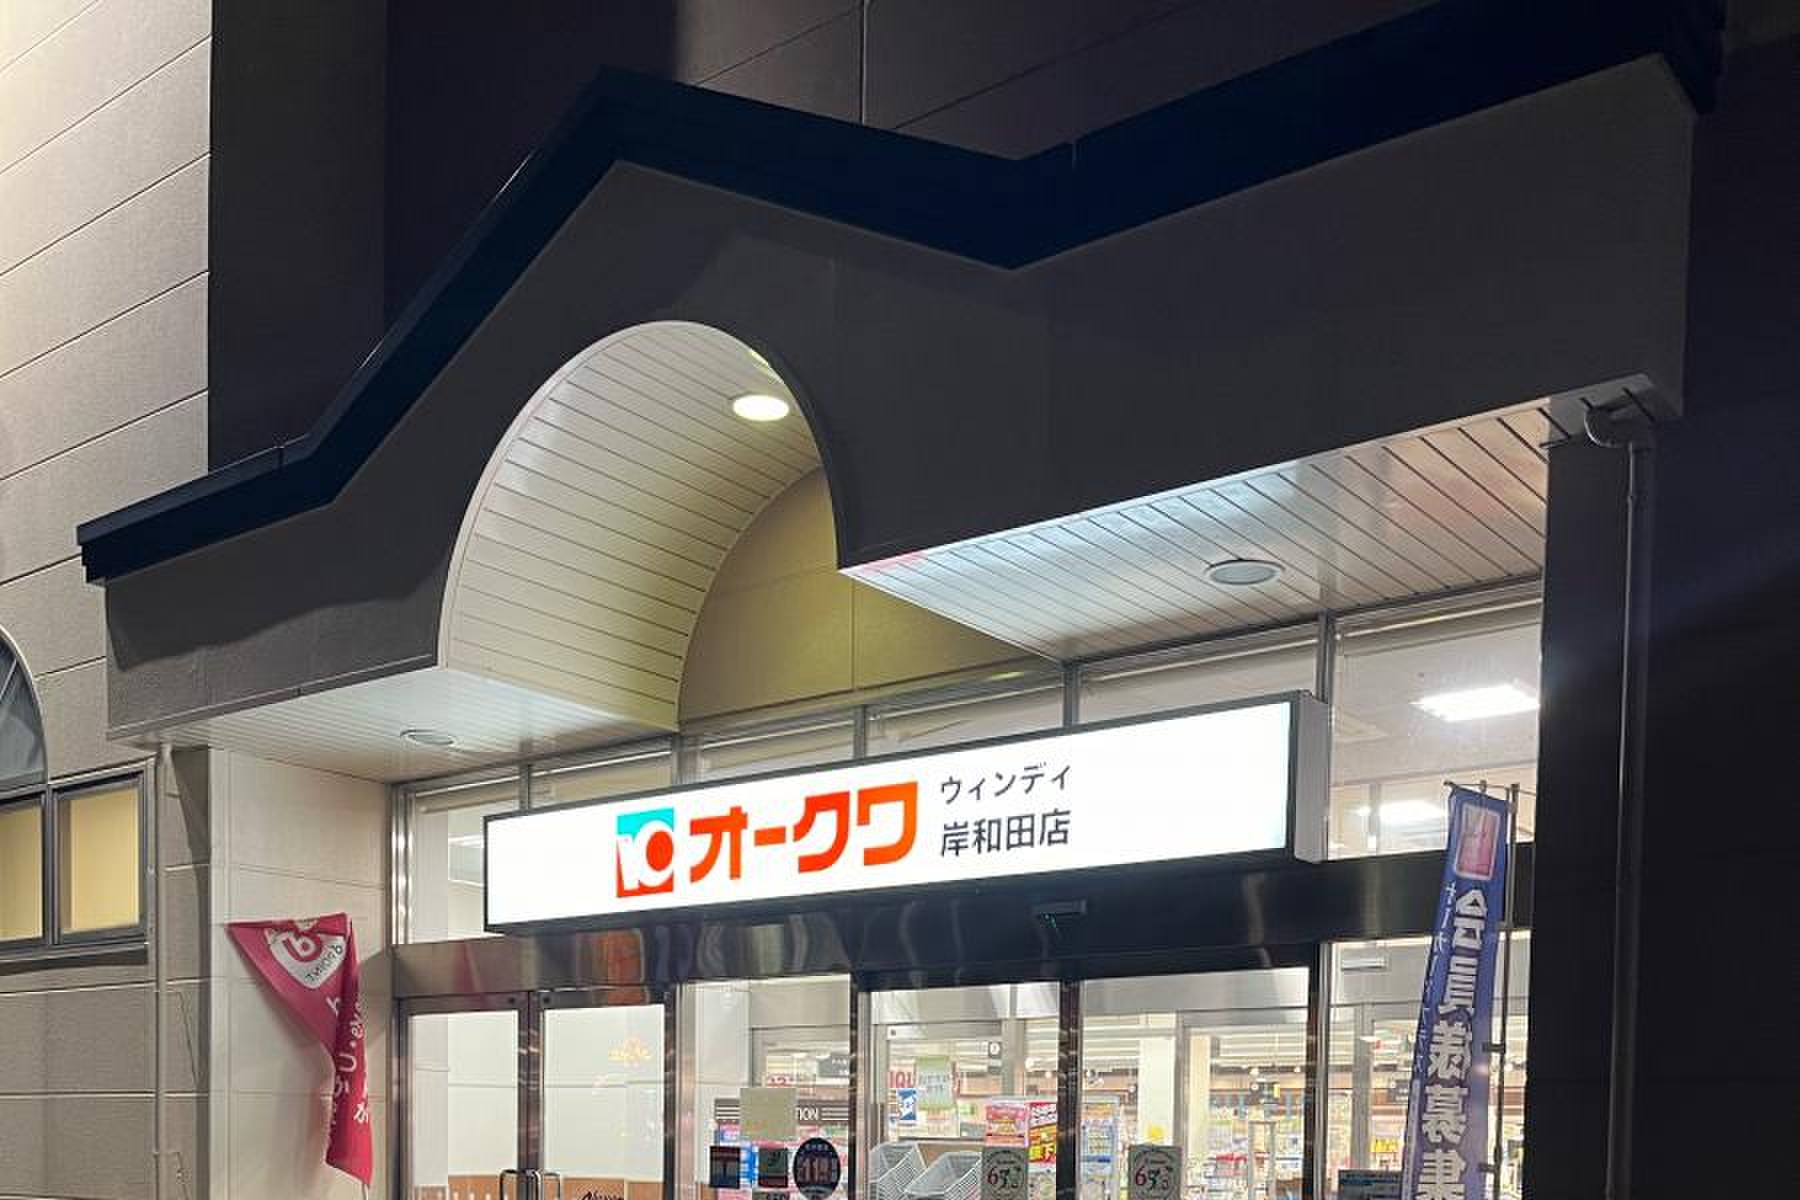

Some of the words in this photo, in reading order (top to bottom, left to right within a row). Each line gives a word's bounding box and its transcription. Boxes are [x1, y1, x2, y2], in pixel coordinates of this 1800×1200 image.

[940, 761, 1071, 805] ウィンディ
[689, 780, 918, 884] オークワ
[940, 808, 1072, 858] 岸和田店
